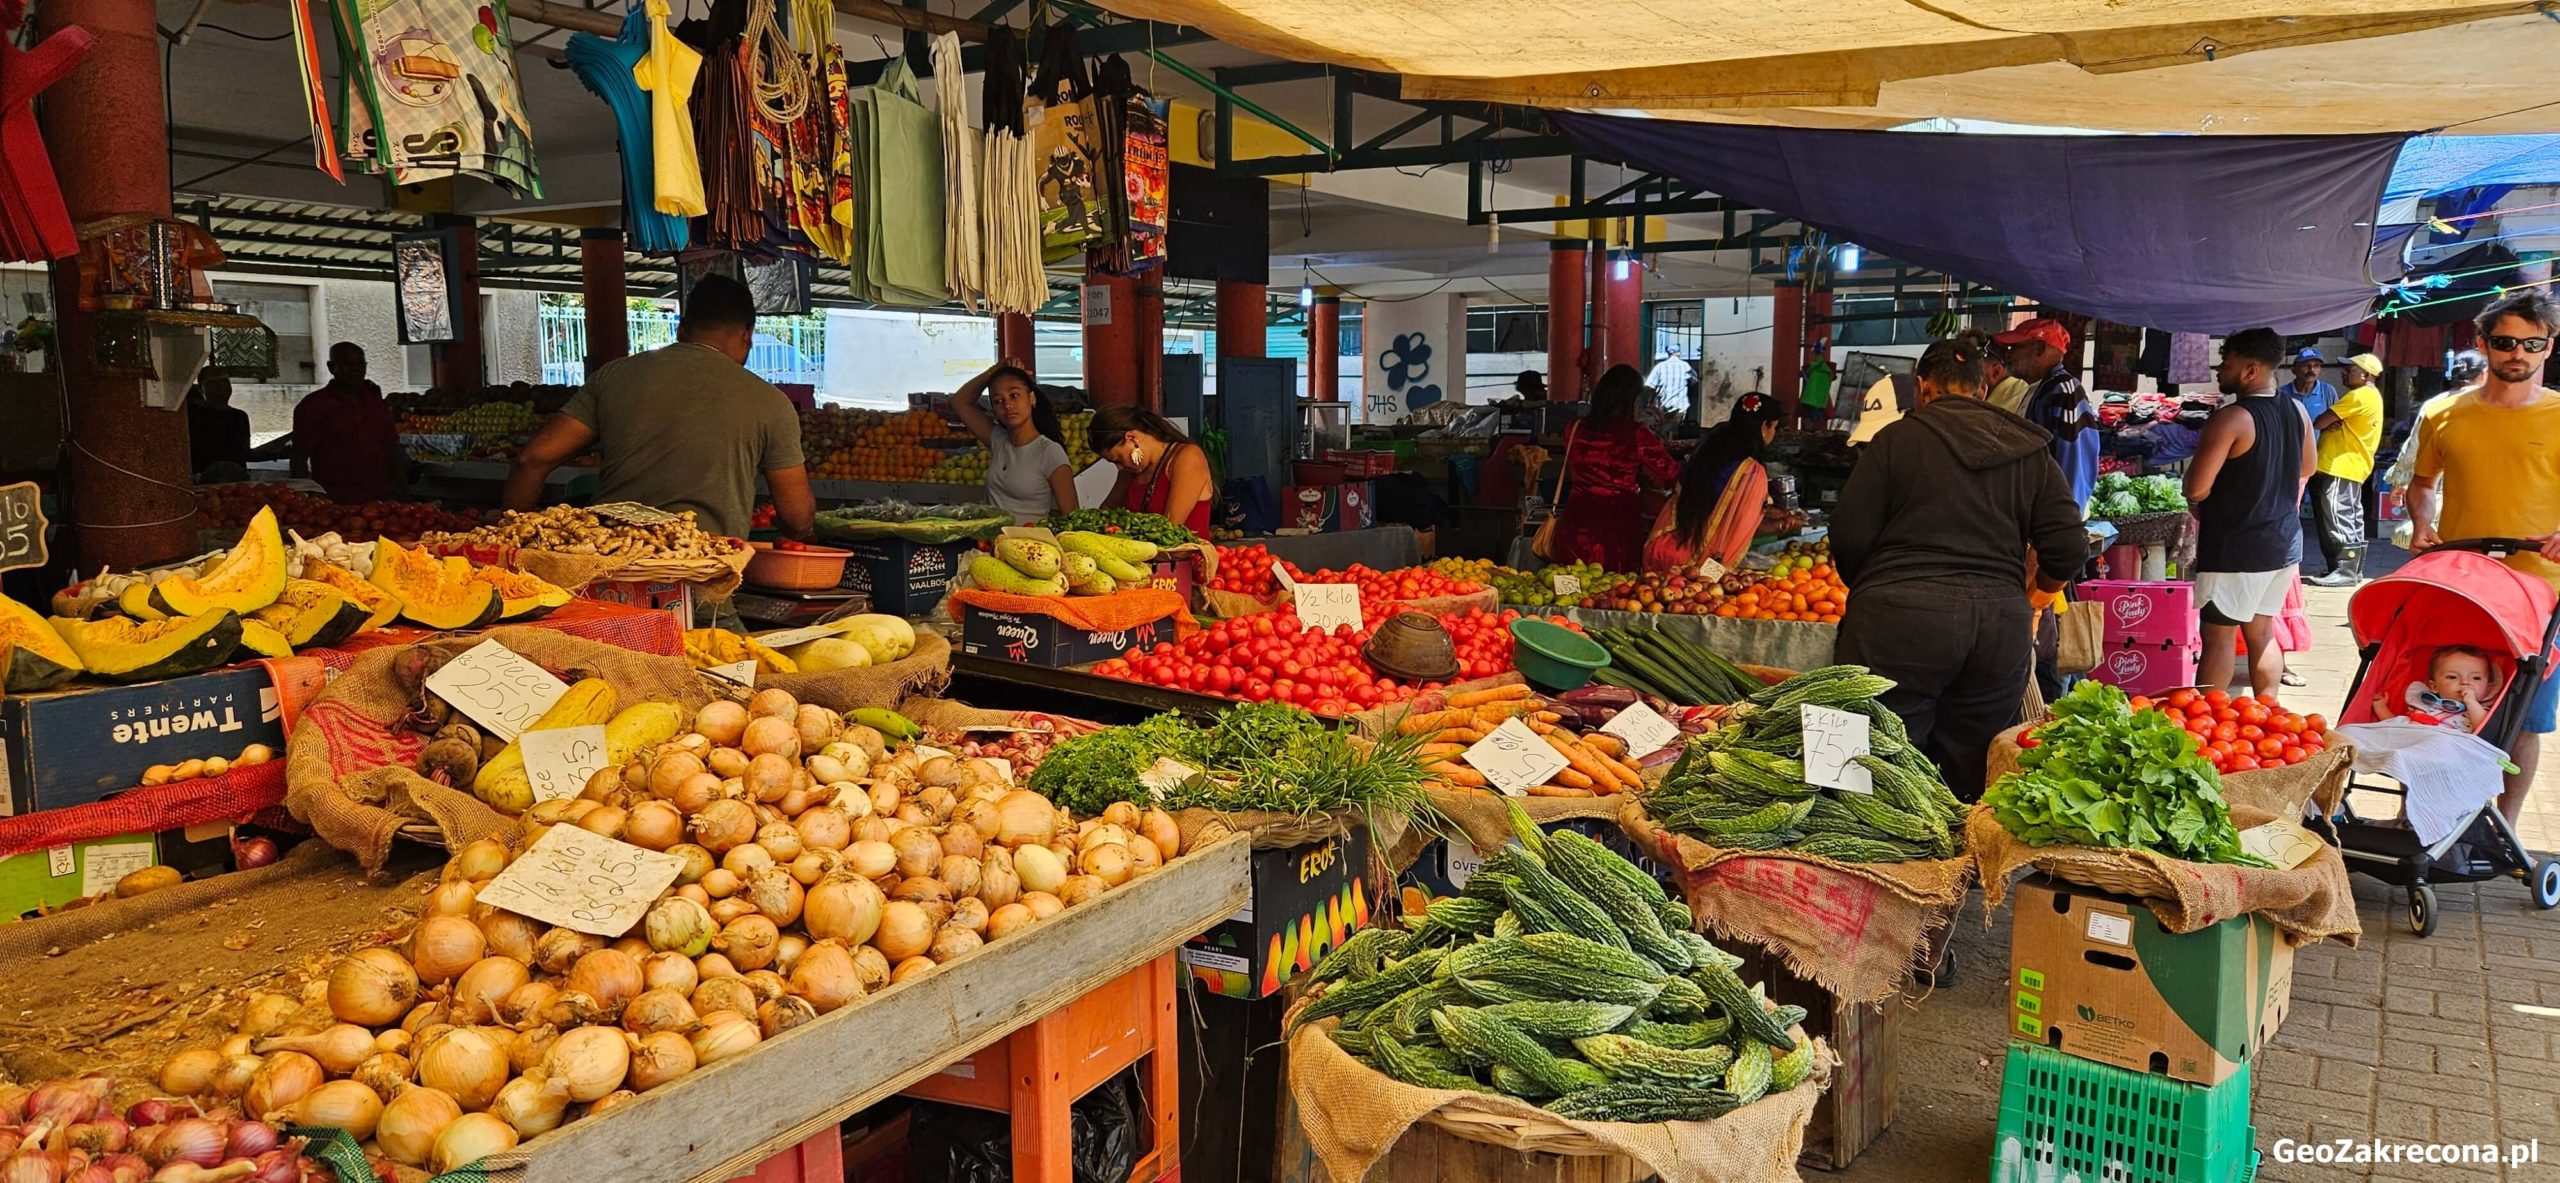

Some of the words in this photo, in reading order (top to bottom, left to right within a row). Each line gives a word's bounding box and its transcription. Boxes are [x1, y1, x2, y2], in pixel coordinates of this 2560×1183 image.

[1368, 394, 1397, 415] JHS
[909, 578, 946, 591] VAALBOS
[1299, 585, 1320, 607] 1/2
[2118, 597, 2144, 612] Pink
[2122, 606, 2146, 619] Lady
[996, 624, 1039, 649] Queen
[1088, 630, 1127, 651] Queen
[2114, 653, 2139, 668] Pink
[2118, 663, 2142, 675] Lady
[111, 693, 233, 720] PARTNERS
[112, 706, 243, 744] Twente
[1300, 840, 1336, 884] EROS
[1204, 945, 1223, 953] PEARS
[2096, 1013, 2136, 1030] BETKO
